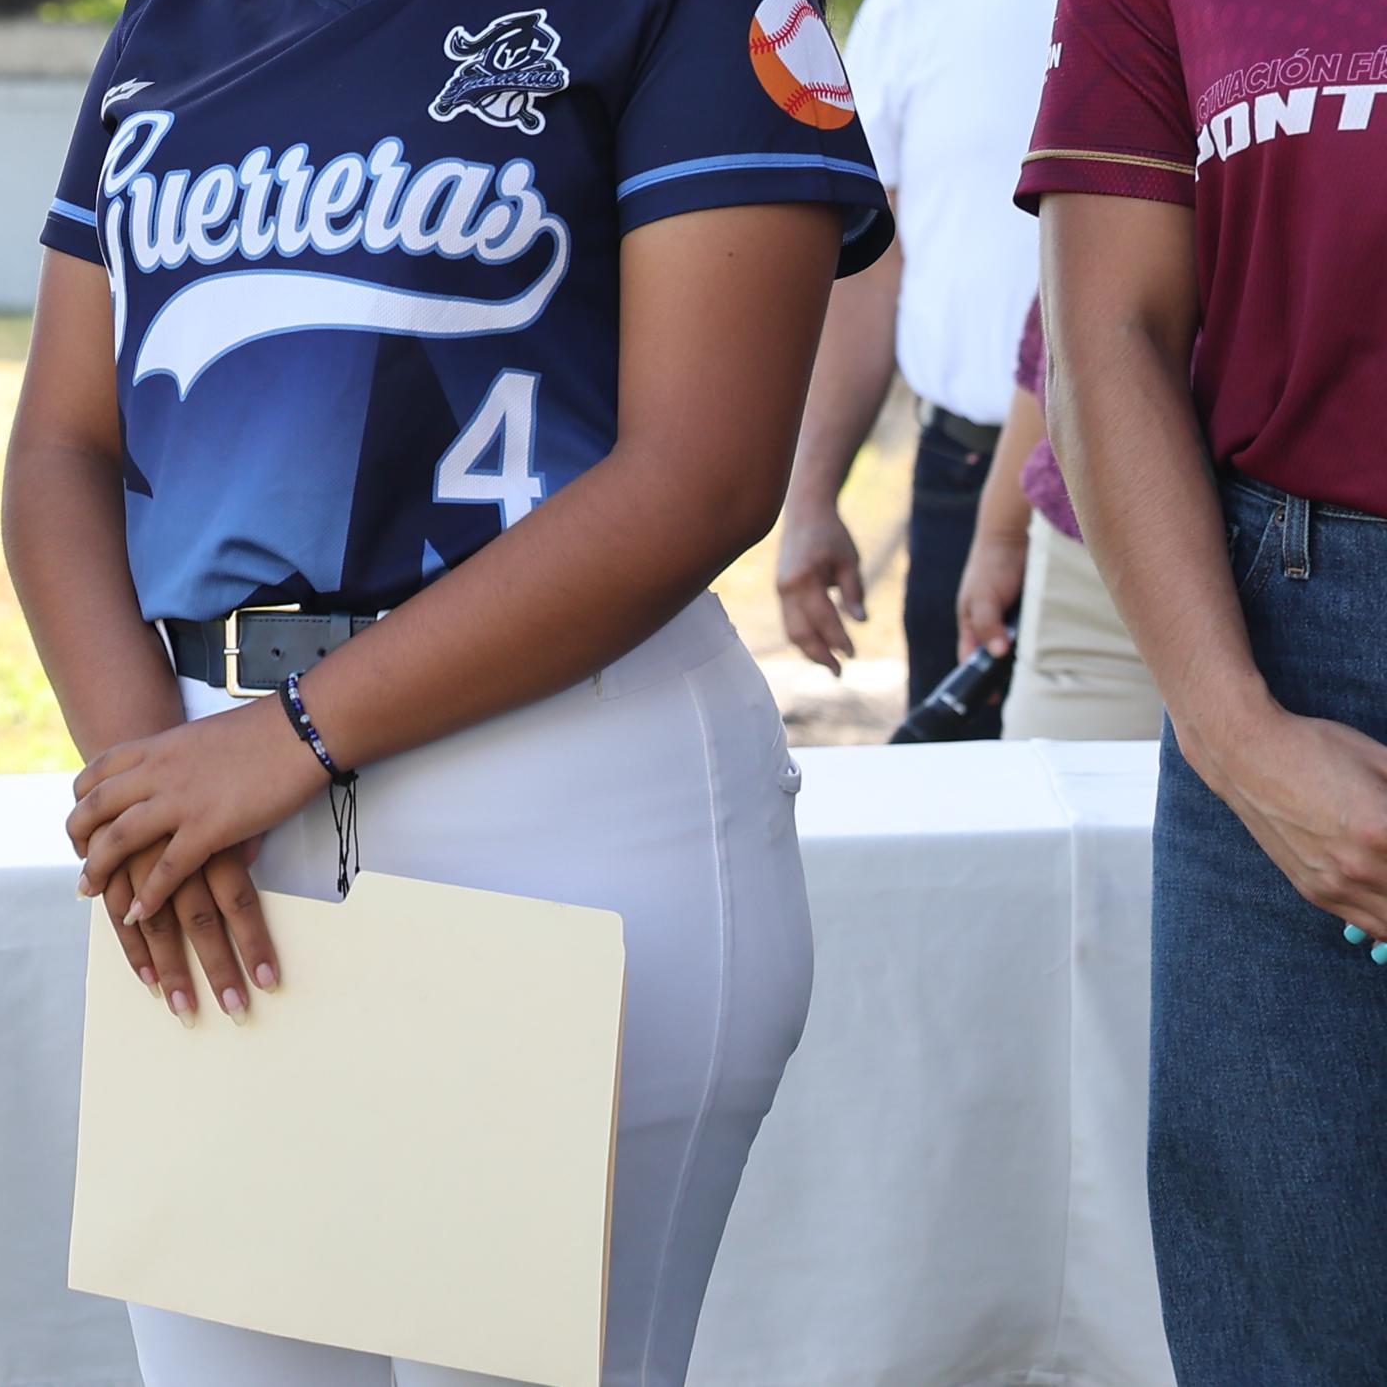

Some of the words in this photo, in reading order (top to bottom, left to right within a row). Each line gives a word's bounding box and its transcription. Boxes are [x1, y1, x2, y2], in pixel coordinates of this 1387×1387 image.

[1196, 48, 1343, 132] CTIVACIÓN
[96, 111, 552, 364] Guerreras
[432, 367, 547, 533] 4
